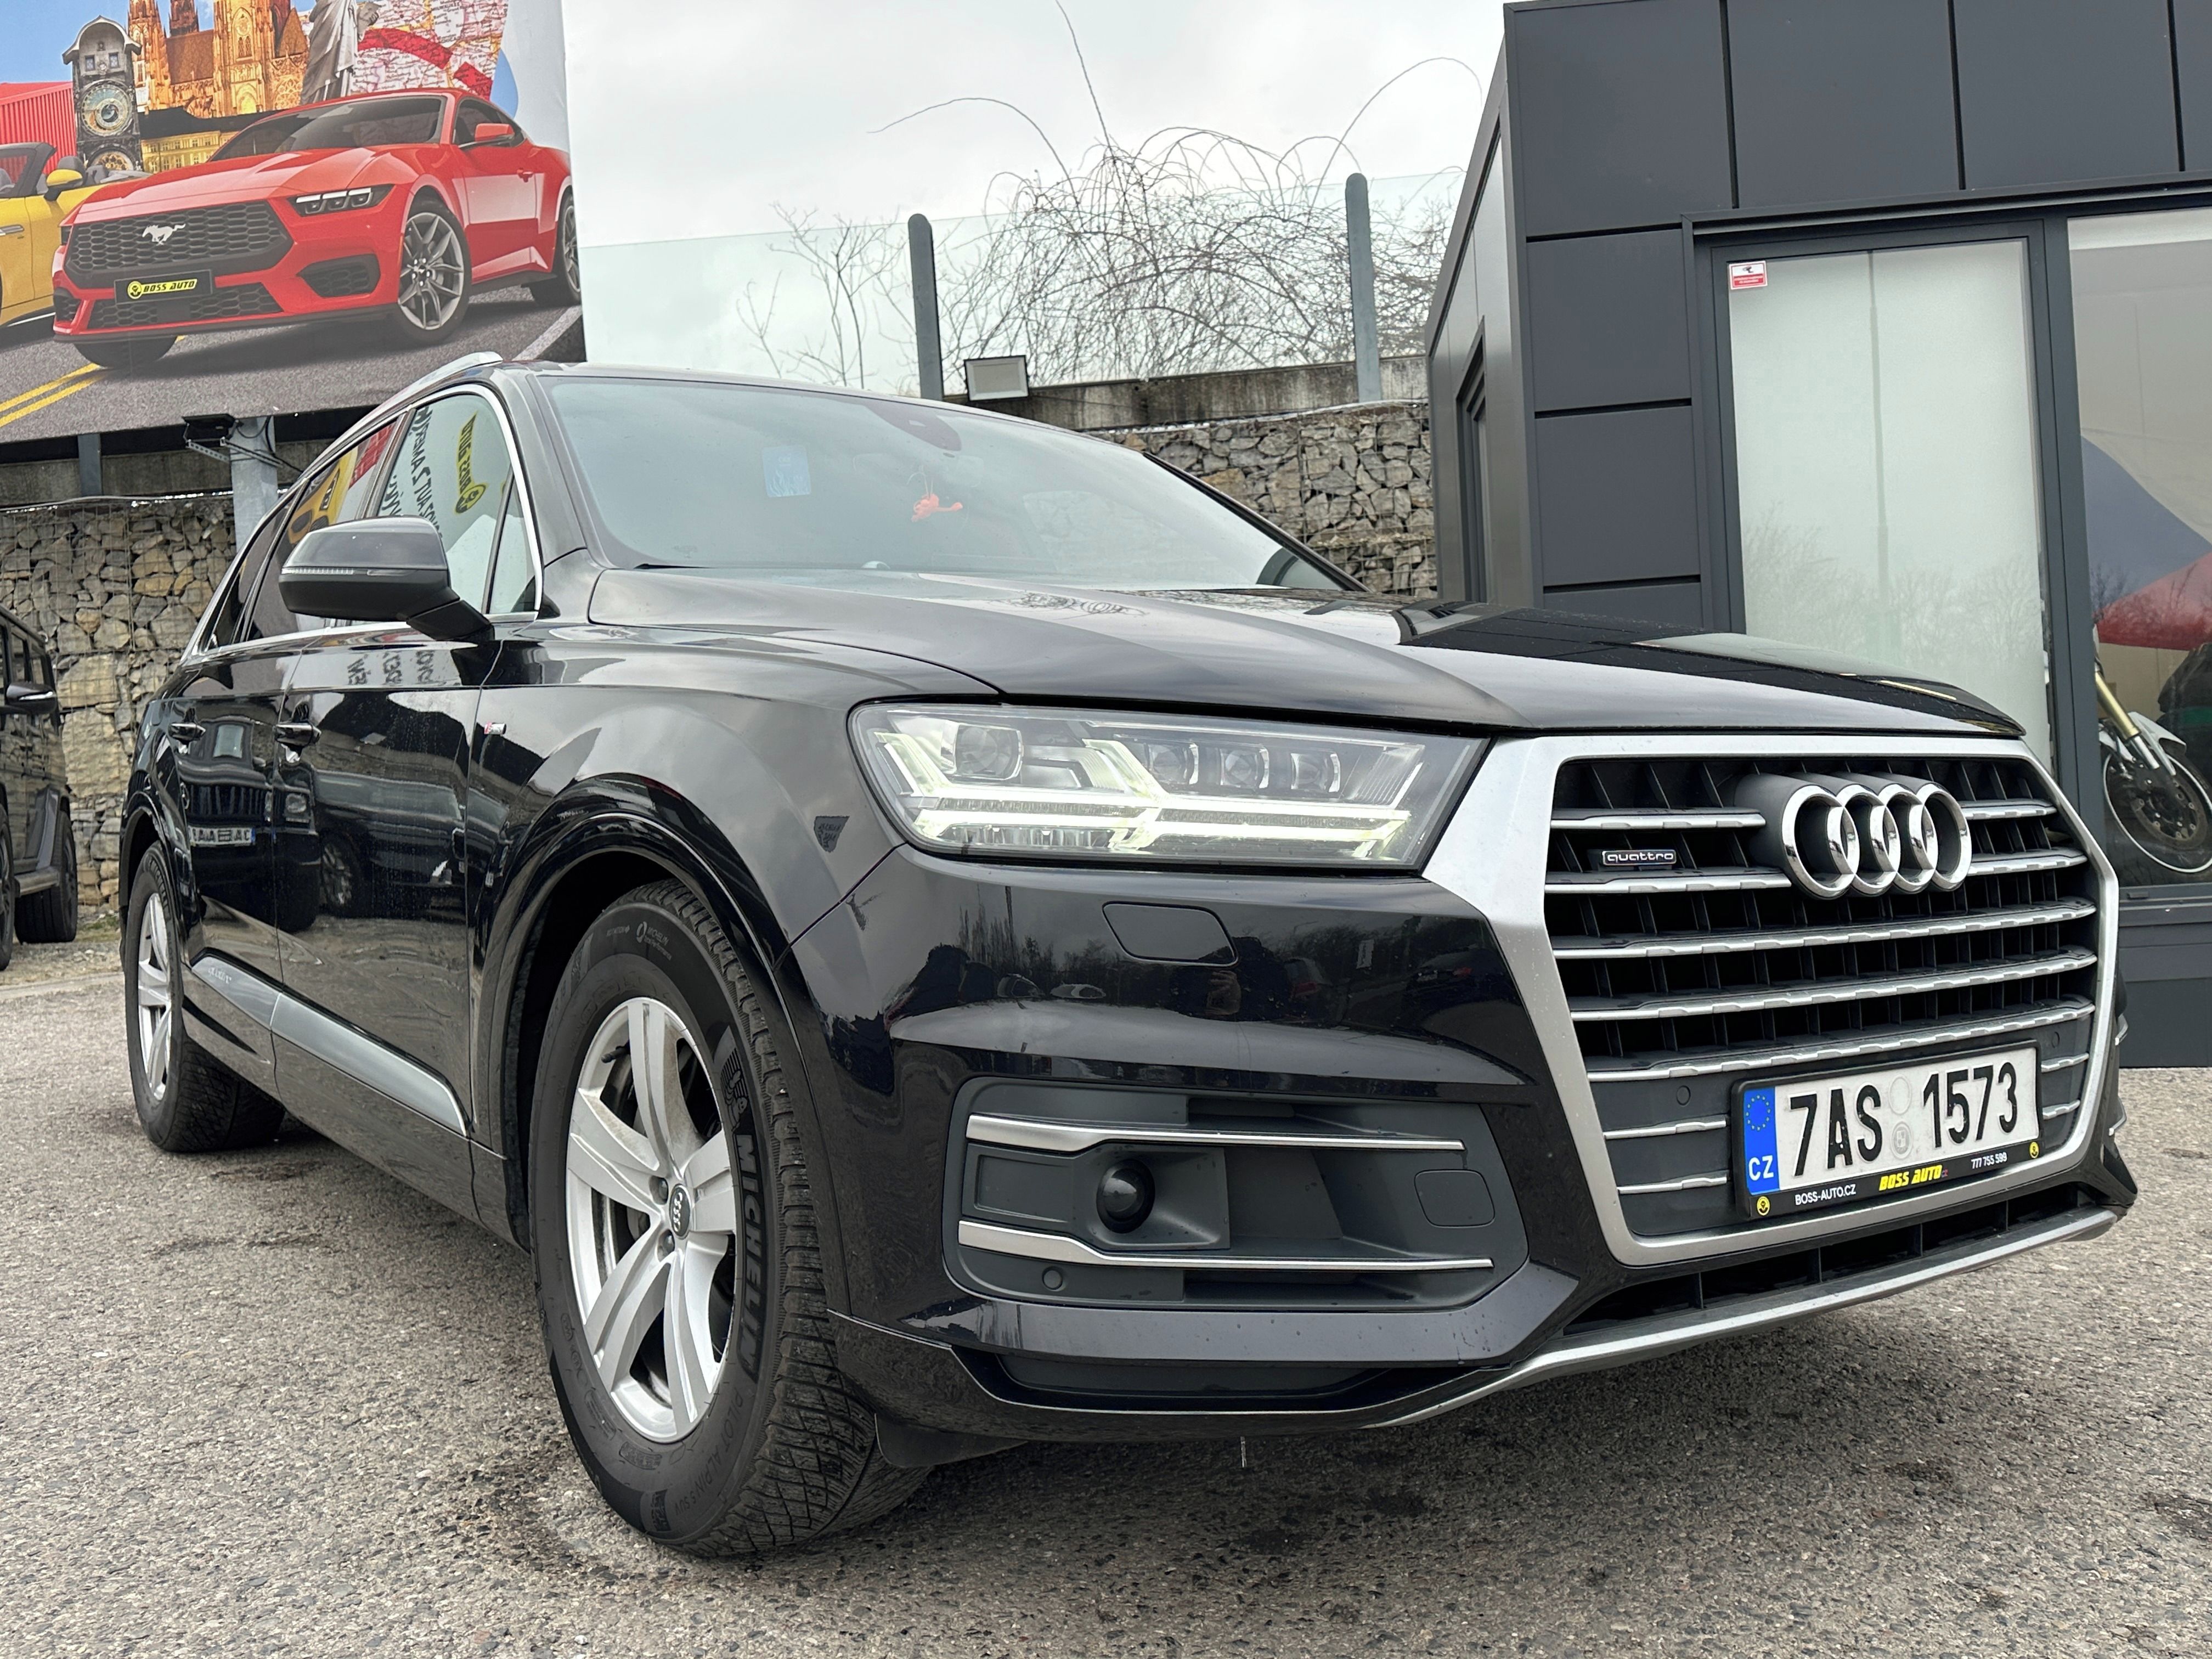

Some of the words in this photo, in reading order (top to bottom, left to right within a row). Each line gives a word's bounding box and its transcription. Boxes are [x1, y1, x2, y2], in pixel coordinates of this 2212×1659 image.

[143, 283, 166, 292] BOSS
[169, 280, 195, 290] AUTO
[1607, 851, 1674, 863] quattro
[1789, 1085, 1883, 1177] 7AS
[1922, 1061, 2018, 1148] 1573
[1748, 1154, 1775, 1182] CZ
[1971, 1158, 1982, 1169] 777
[1983, 1154, 1995, 1166] 755
[1995, 1152, 2007, 1164] 599
[1878, 1171, 1910, 1192] BOSS
[1911, 1164, 1943, 1184] AUTO
[1795, 1184, 1857, 1205] BOSS-AUTO.CZ
[736, 1134, 763, 1367] MICHELIN
[721, 1387, 743, 1453] PILOT
[695, 1444, 721, 1498] ALPIN
[674, 1496, 690, 1516] SUV
